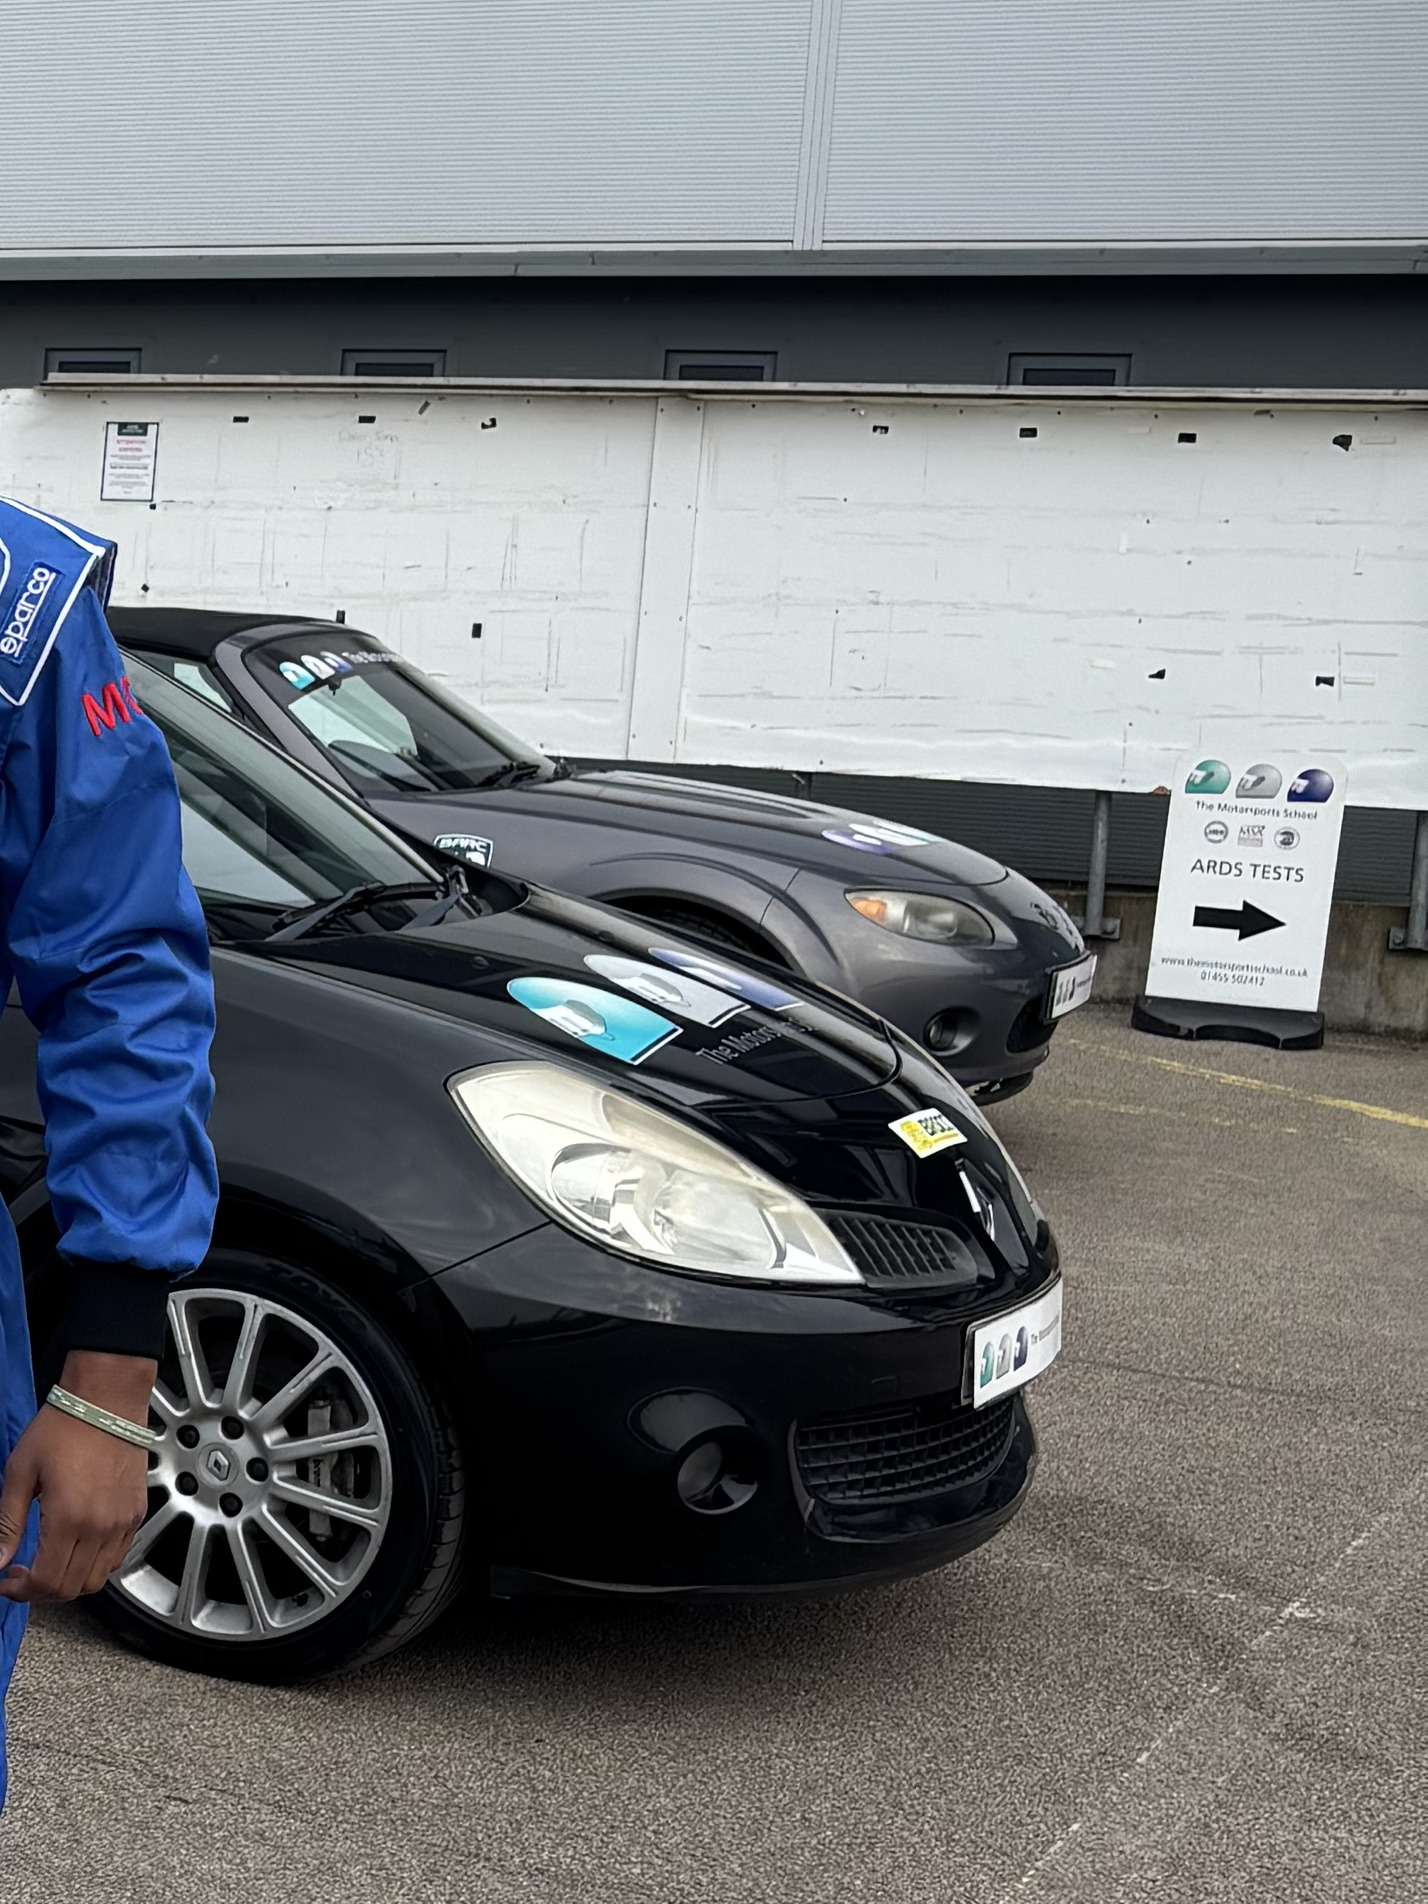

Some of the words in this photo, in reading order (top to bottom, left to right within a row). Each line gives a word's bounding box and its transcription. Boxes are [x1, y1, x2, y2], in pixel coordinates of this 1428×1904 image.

[1196, 800, 1214, 811] The
[1190, 858, 1243, 878] ARDS
[1249, 862, 1305, 884] TESTS
